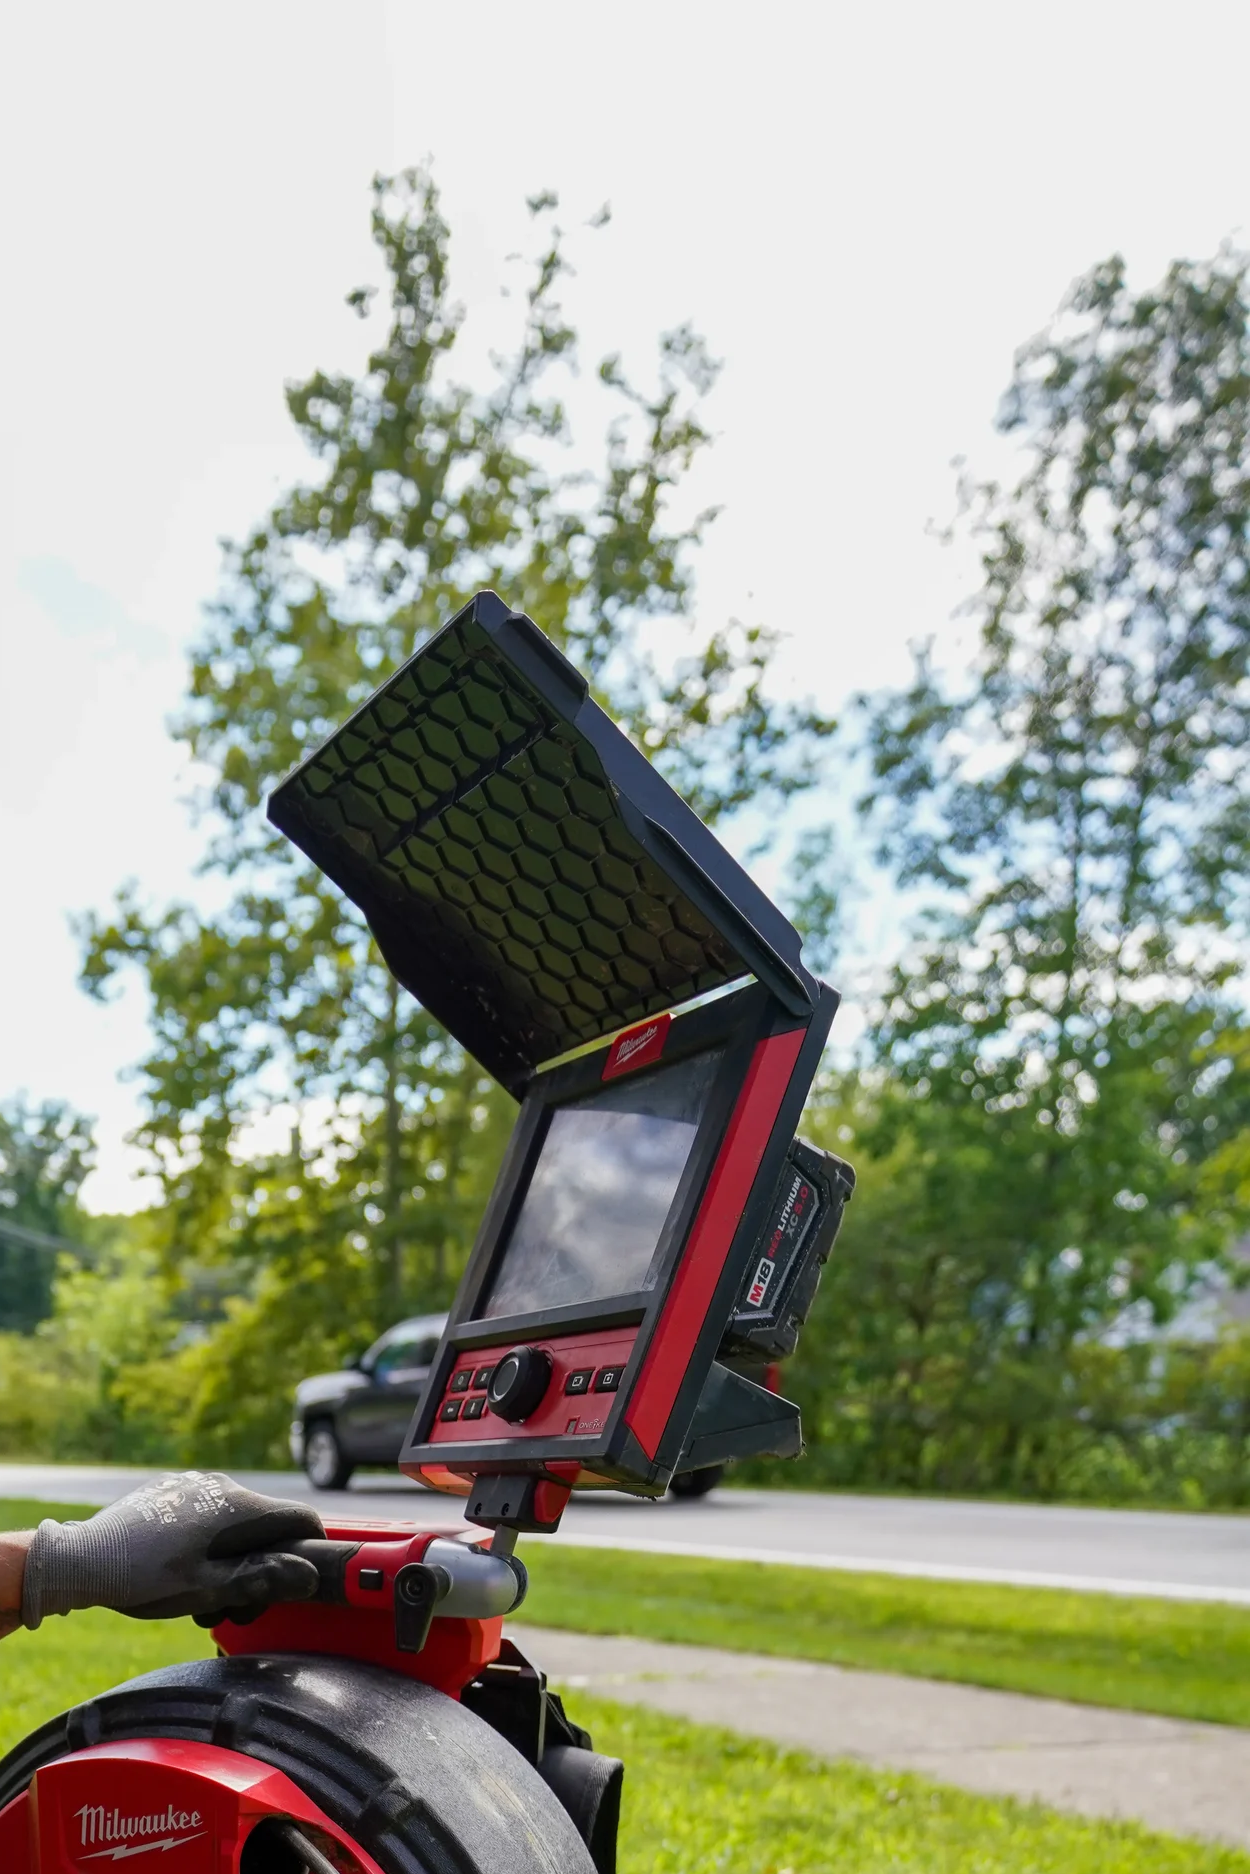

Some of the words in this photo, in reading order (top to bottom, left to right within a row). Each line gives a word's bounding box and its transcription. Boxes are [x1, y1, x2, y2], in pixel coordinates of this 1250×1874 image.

[616, 1025, 658, 1061] Milwaukee
[750, 1261, 772, 1303] M18
[72, 1803, 204, 1847] Milwaukee
